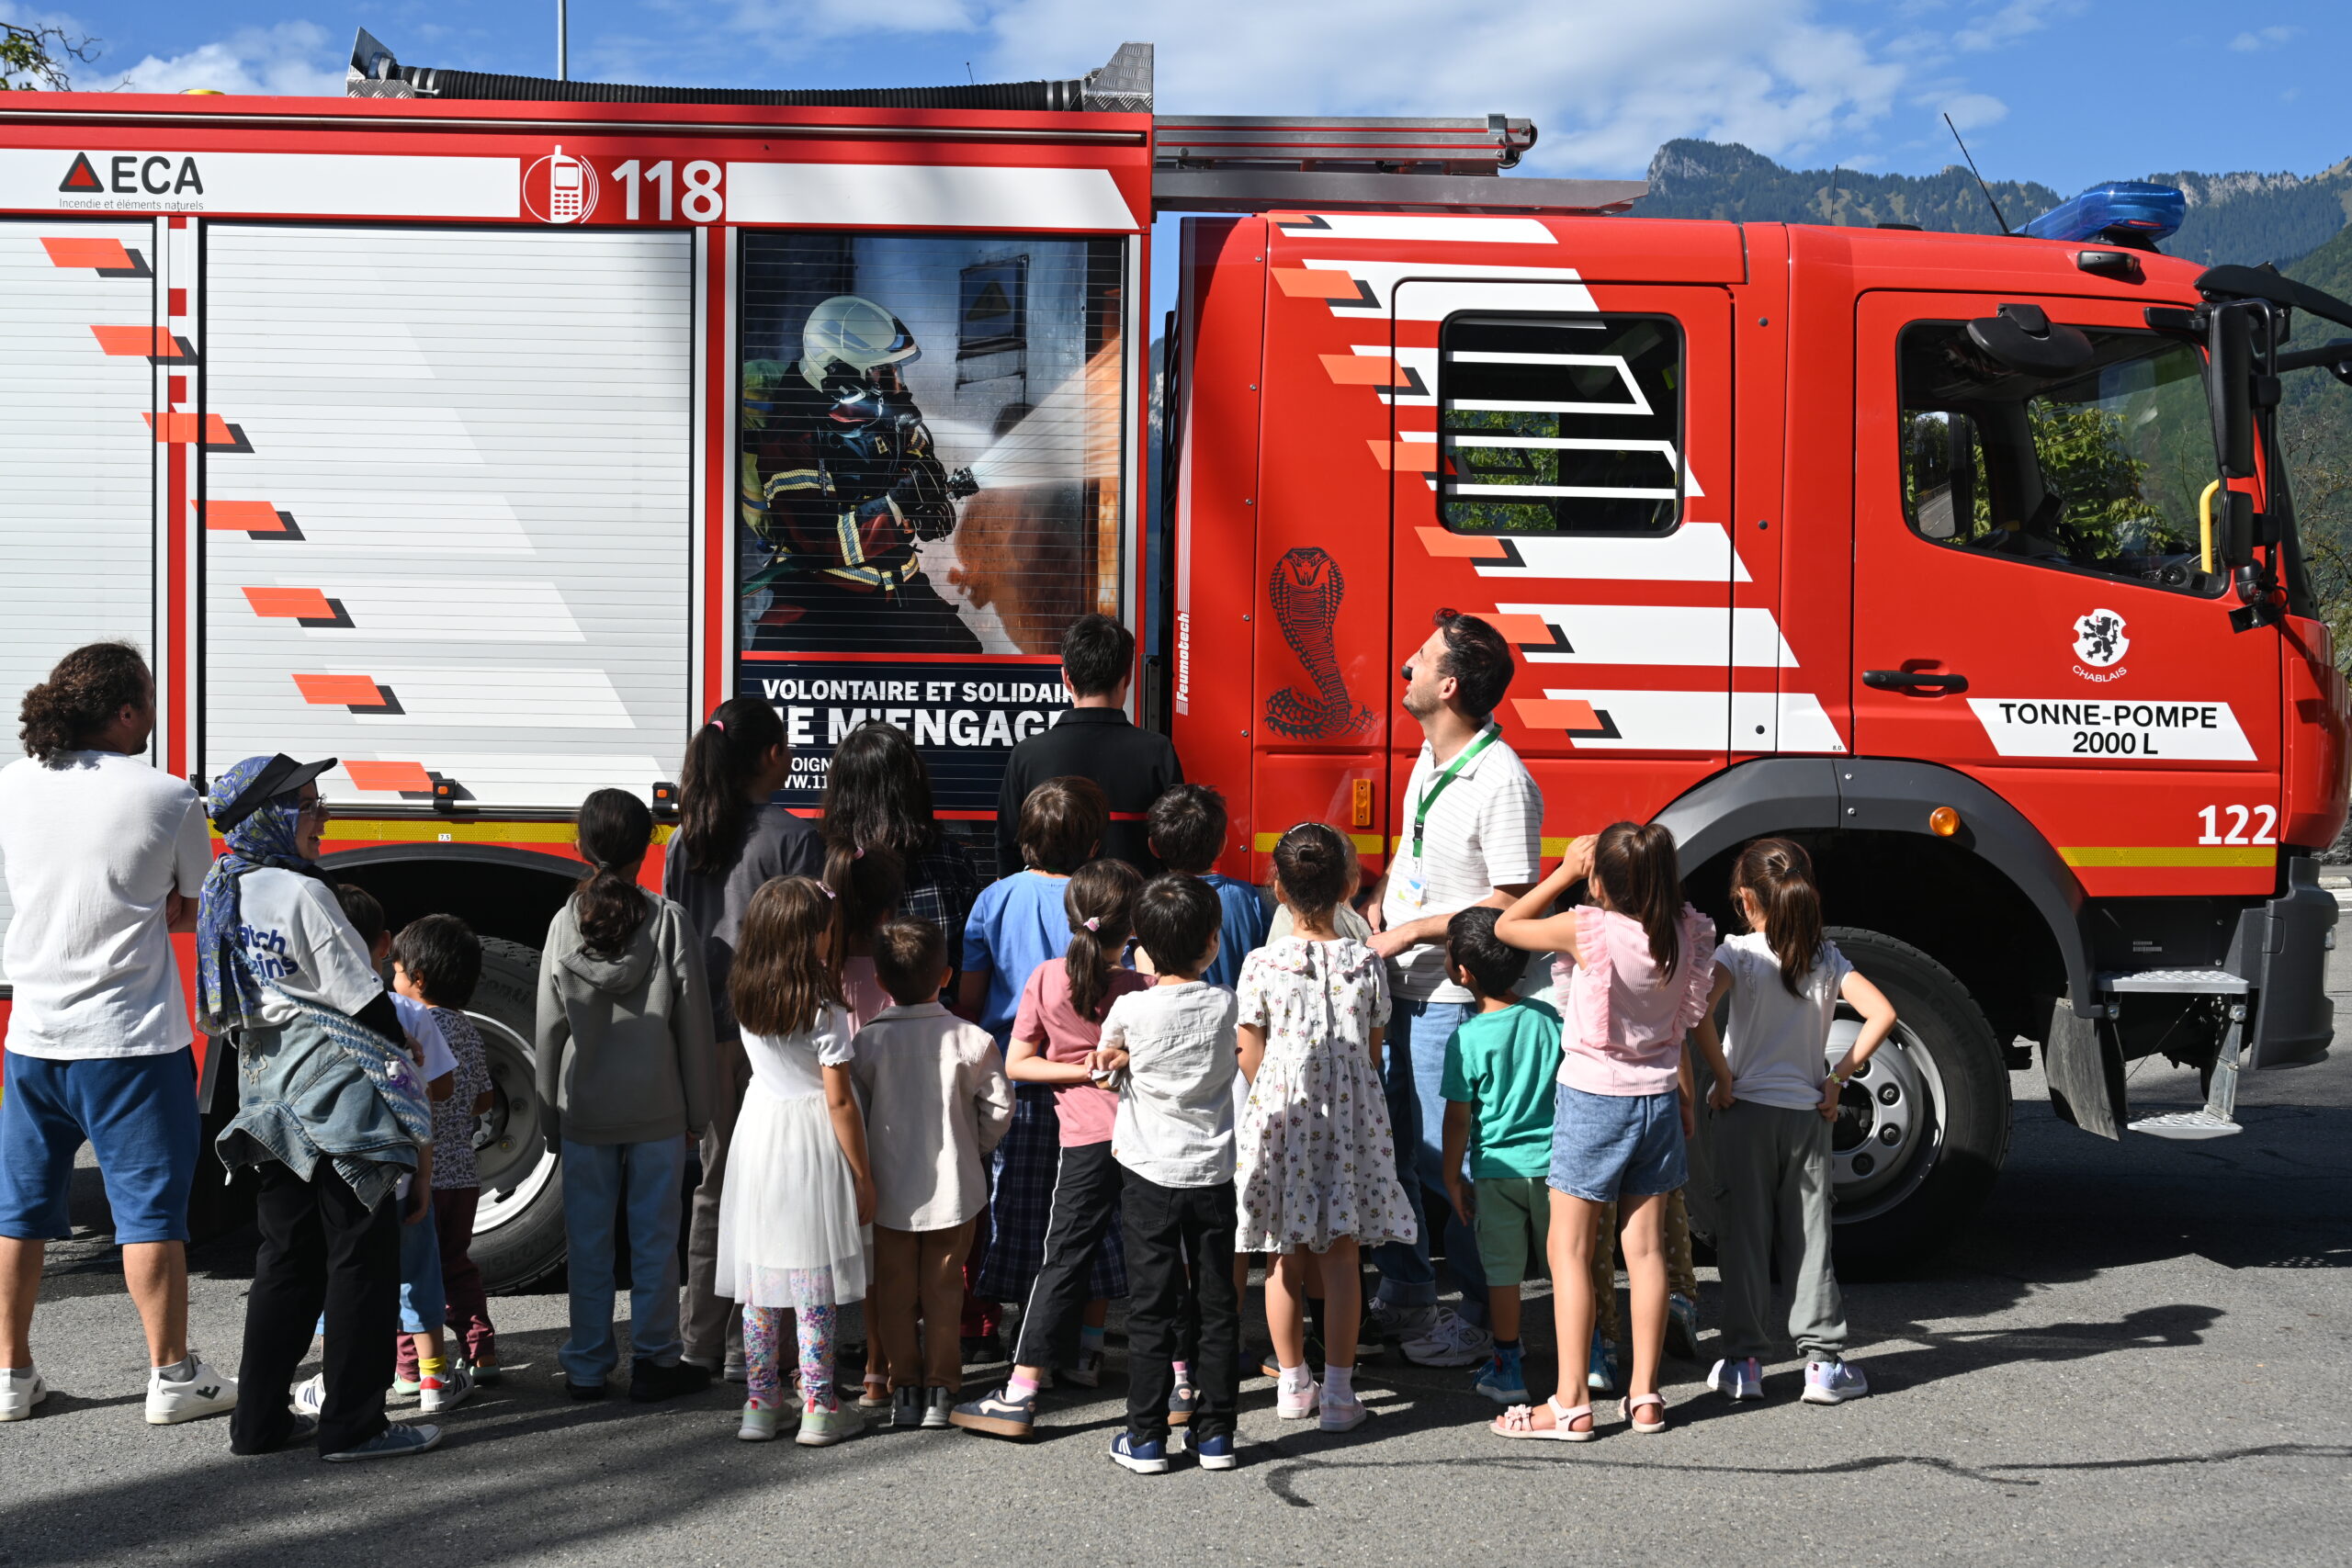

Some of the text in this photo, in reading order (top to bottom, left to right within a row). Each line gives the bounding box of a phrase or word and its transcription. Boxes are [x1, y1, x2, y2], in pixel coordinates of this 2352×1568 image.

[111, 155, 204, 196] ECA
[611, 159, 723, 222] 118
[59, 198, 204, 211] Incendie et éléments naturels
[1176, 612, 1190, 702] Feumotech
[2072, 665, 2128, 682] CHABLAIS
[762, 679, 1075, 704] VOLONTAIRE ET SOLIDAIR
[773, 707, 815, 745] E
[1998, 703, 2218, 728] TONNE-POMPE
[2073, 731, 2159, 755] 2000 L
[2198, 804, 2278, 845] 122
[237, 924, 286, 956] atch
